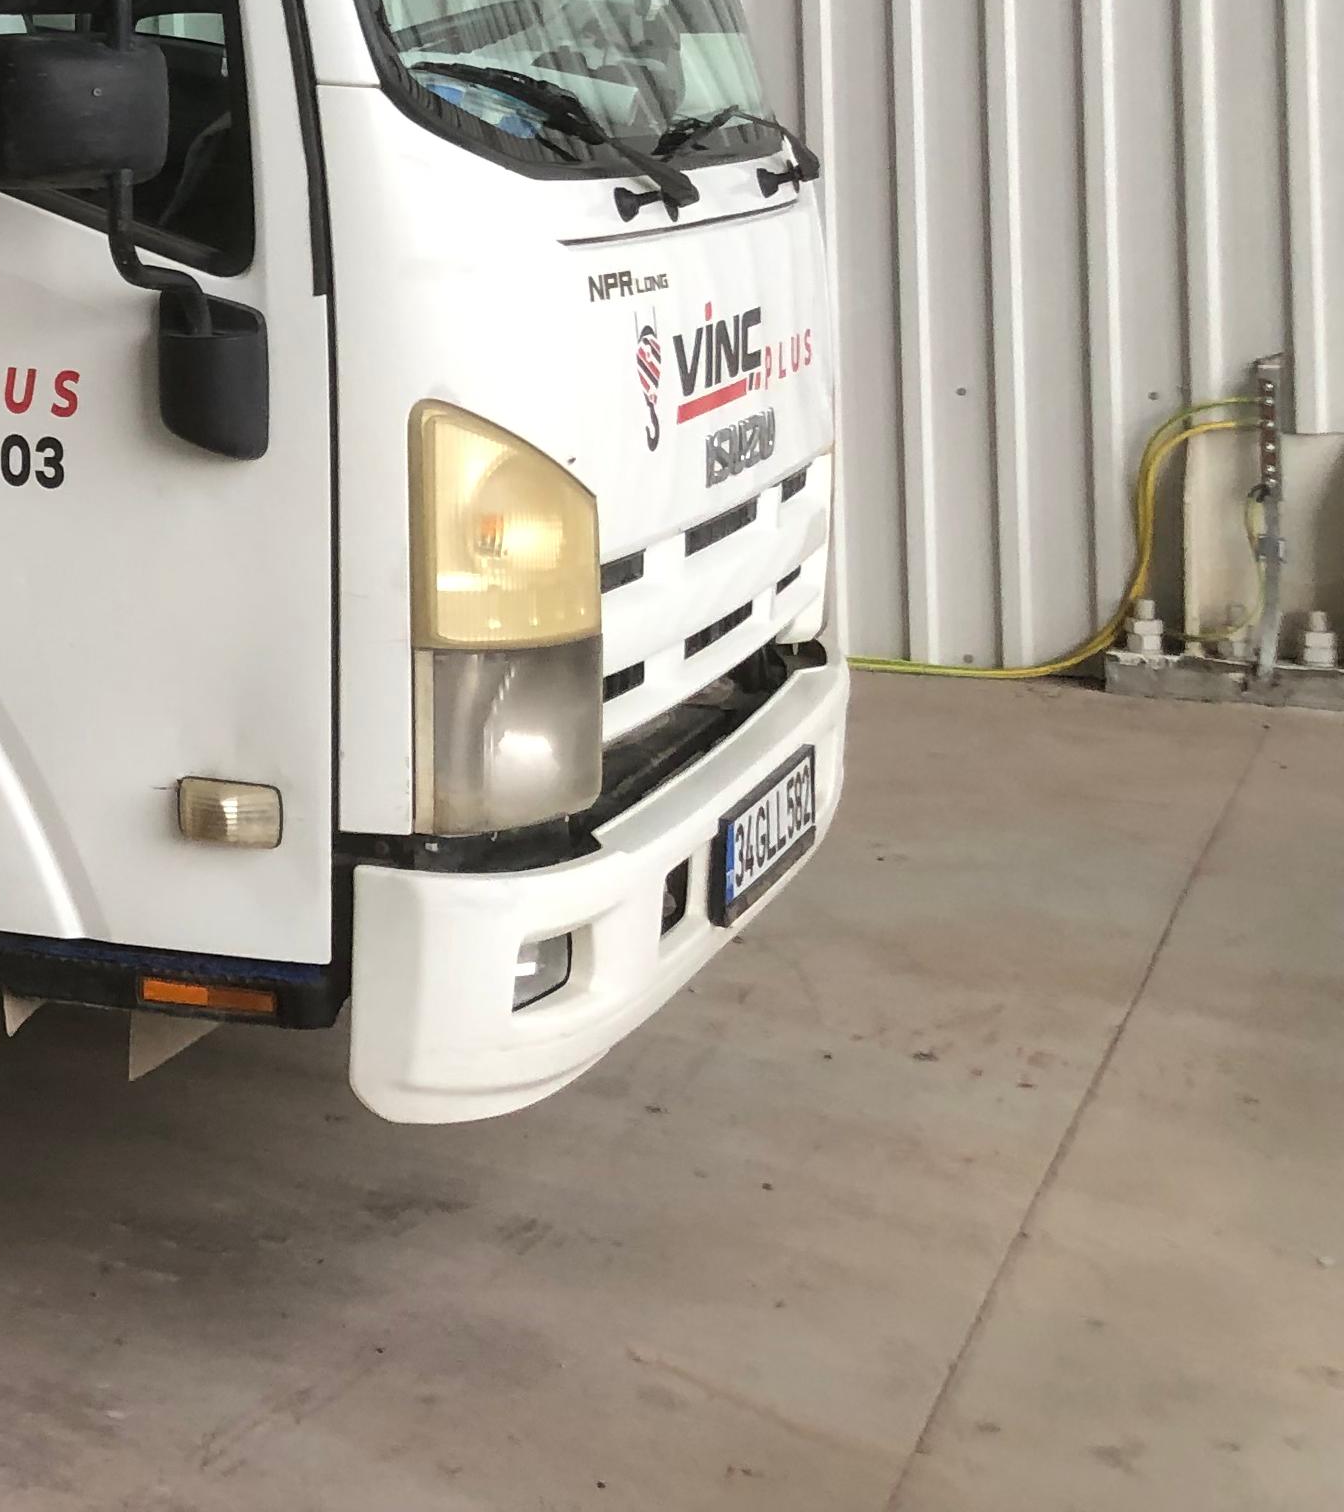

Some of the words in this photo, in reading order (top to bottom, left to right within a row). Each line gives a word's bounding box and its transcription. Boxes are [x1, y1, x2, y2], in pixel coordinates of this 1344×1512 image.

[588, 270, 634, 303] NPR
[635, 273, 670, 294] LONG
[763, 328, 812, 391] PLUS
[0, 434, 66, 490] 03
[705, 406, 776, 489] ISUZU
[735, 814, 754, 888] 34
[755, 790, 787, 868] GLL
[786, 764, 811, 839] 582
